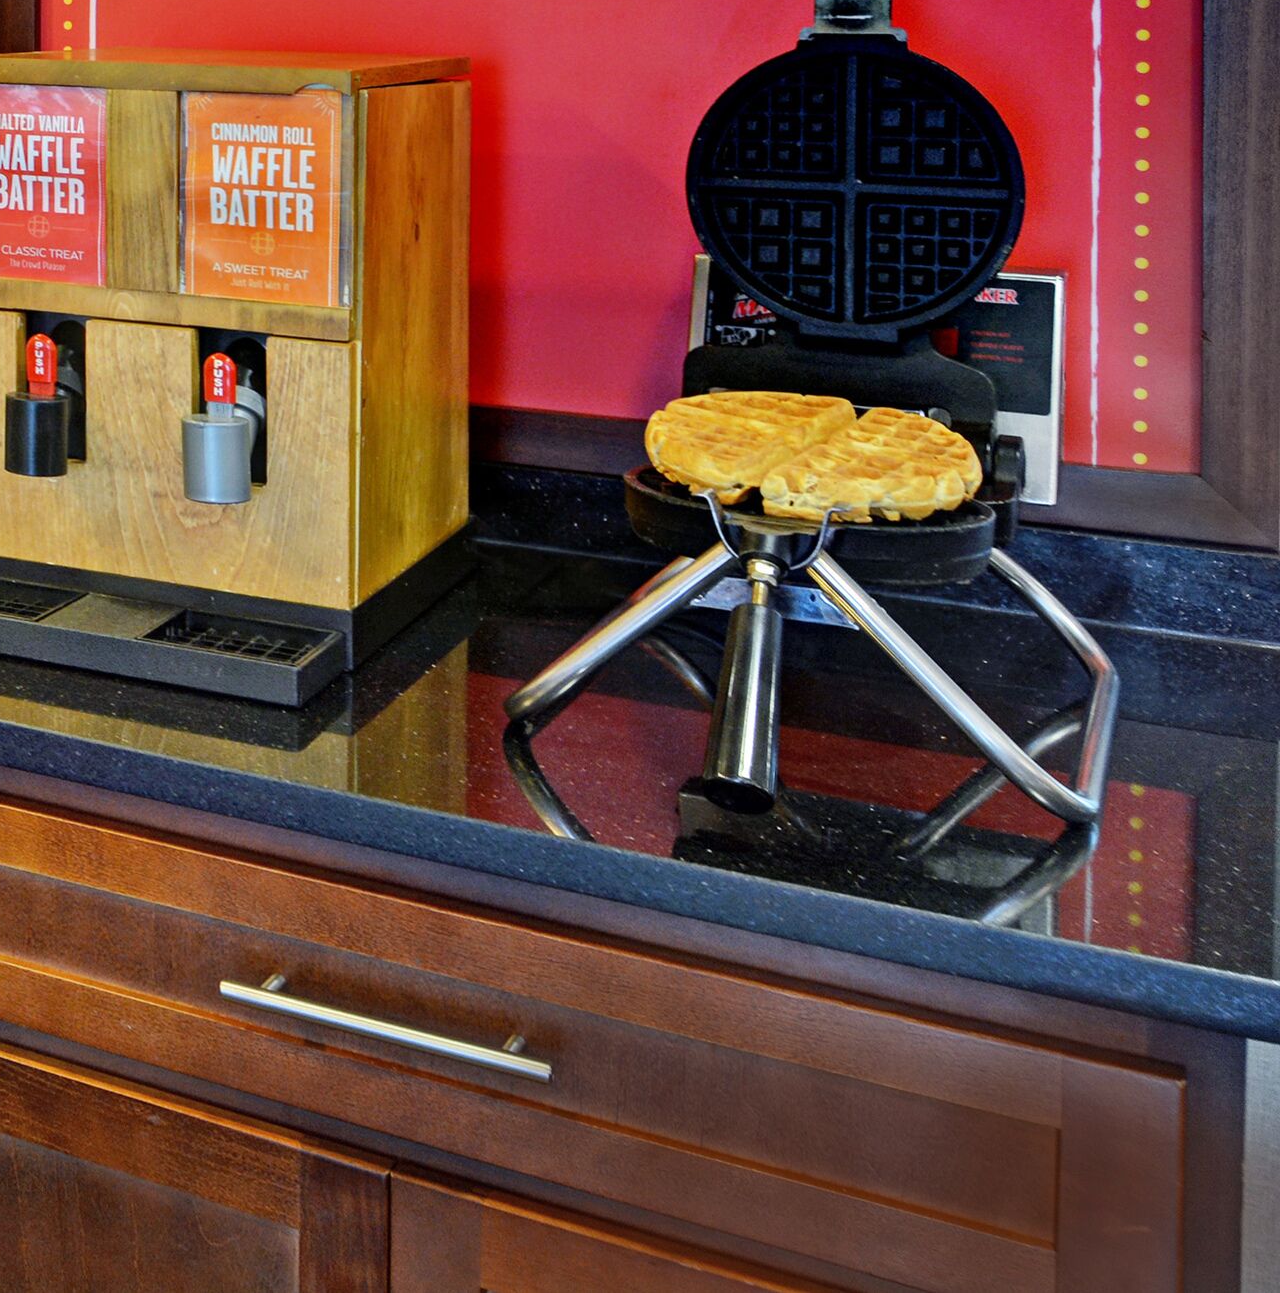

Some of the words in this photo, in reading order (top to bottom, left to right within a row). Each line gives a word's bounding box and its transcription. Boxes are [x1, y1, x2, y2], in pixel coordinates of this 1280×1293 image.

[38, 114, 85, 134] VANILLA
[210, 122, 279, 144] CINNAMON
[282, 125, 315, 147] ROLL
[210, 143, 317, 191] WAFFLE
[209, 185, 315, 233] BATTER
[1, 245, 47, 258] CLASSIC
[48, 248, 85, 261] TREAT
[212, 262, 221, 272] A
[223, 262, 266, 276] SWEET
[269, 266, 310, 280] TREAT
[34, 340, 45, 376] PUSH
[213, 358, 224, 397] PUSH
